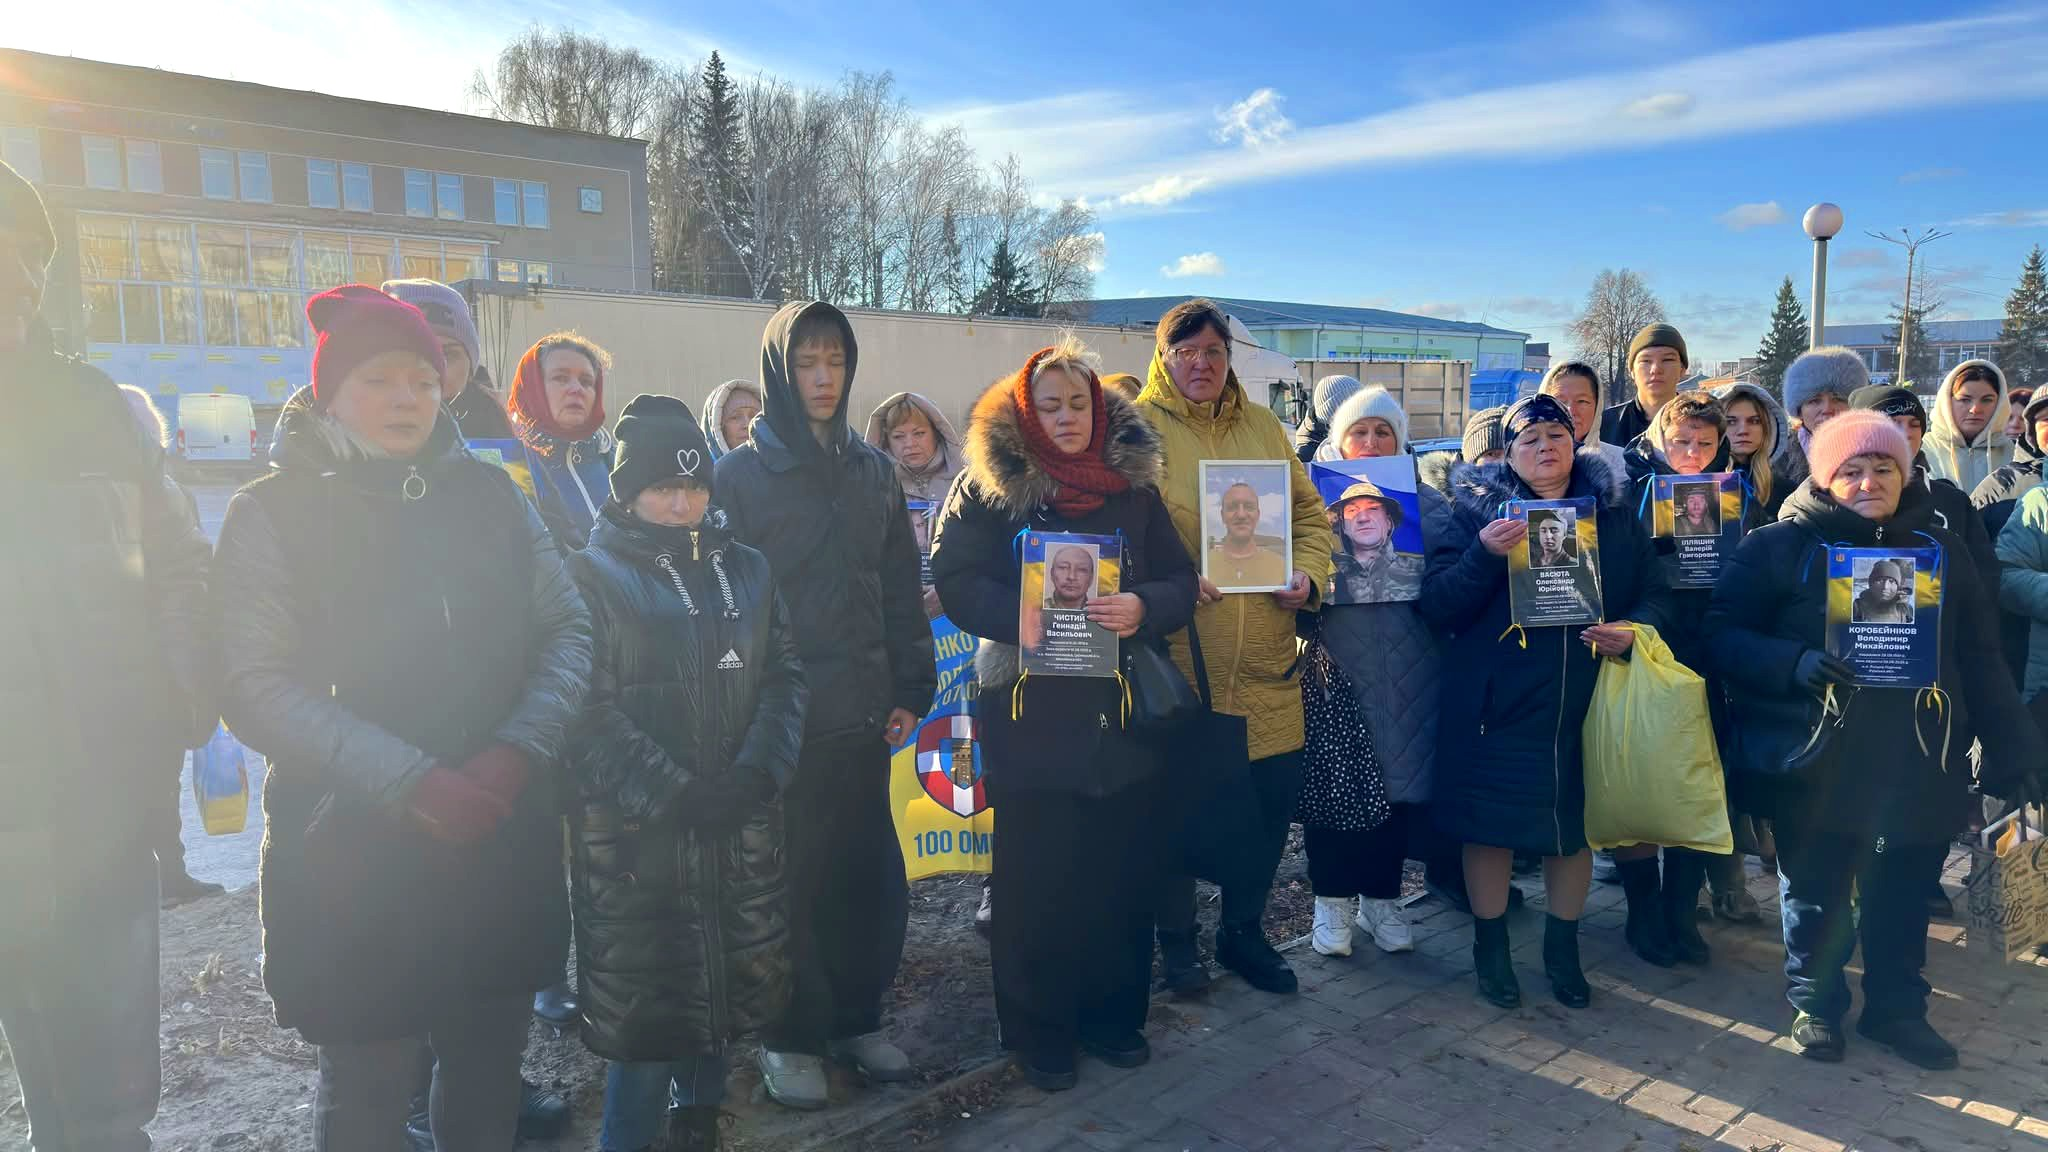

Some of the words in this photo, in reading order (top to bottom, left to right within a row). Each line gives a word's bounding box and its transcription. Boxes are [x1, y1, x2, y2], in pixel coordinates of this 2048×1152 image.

[1540, 570, 1570, 578] ВАСЮТА
[1536, 578, 1575, 586] Олександр
[1054, 613, 1086, 621] ЧИСТИЙ
[1052, 622, 1087, 630] Геннадій
[1046, 630, 1093, 638] Васильович
[1857, 634, 1909, 643] Володимир
[934, 631, 974, 662] НКО
[717, 661, 744, 669] adidas
[914, 830, 953, 858] 100
